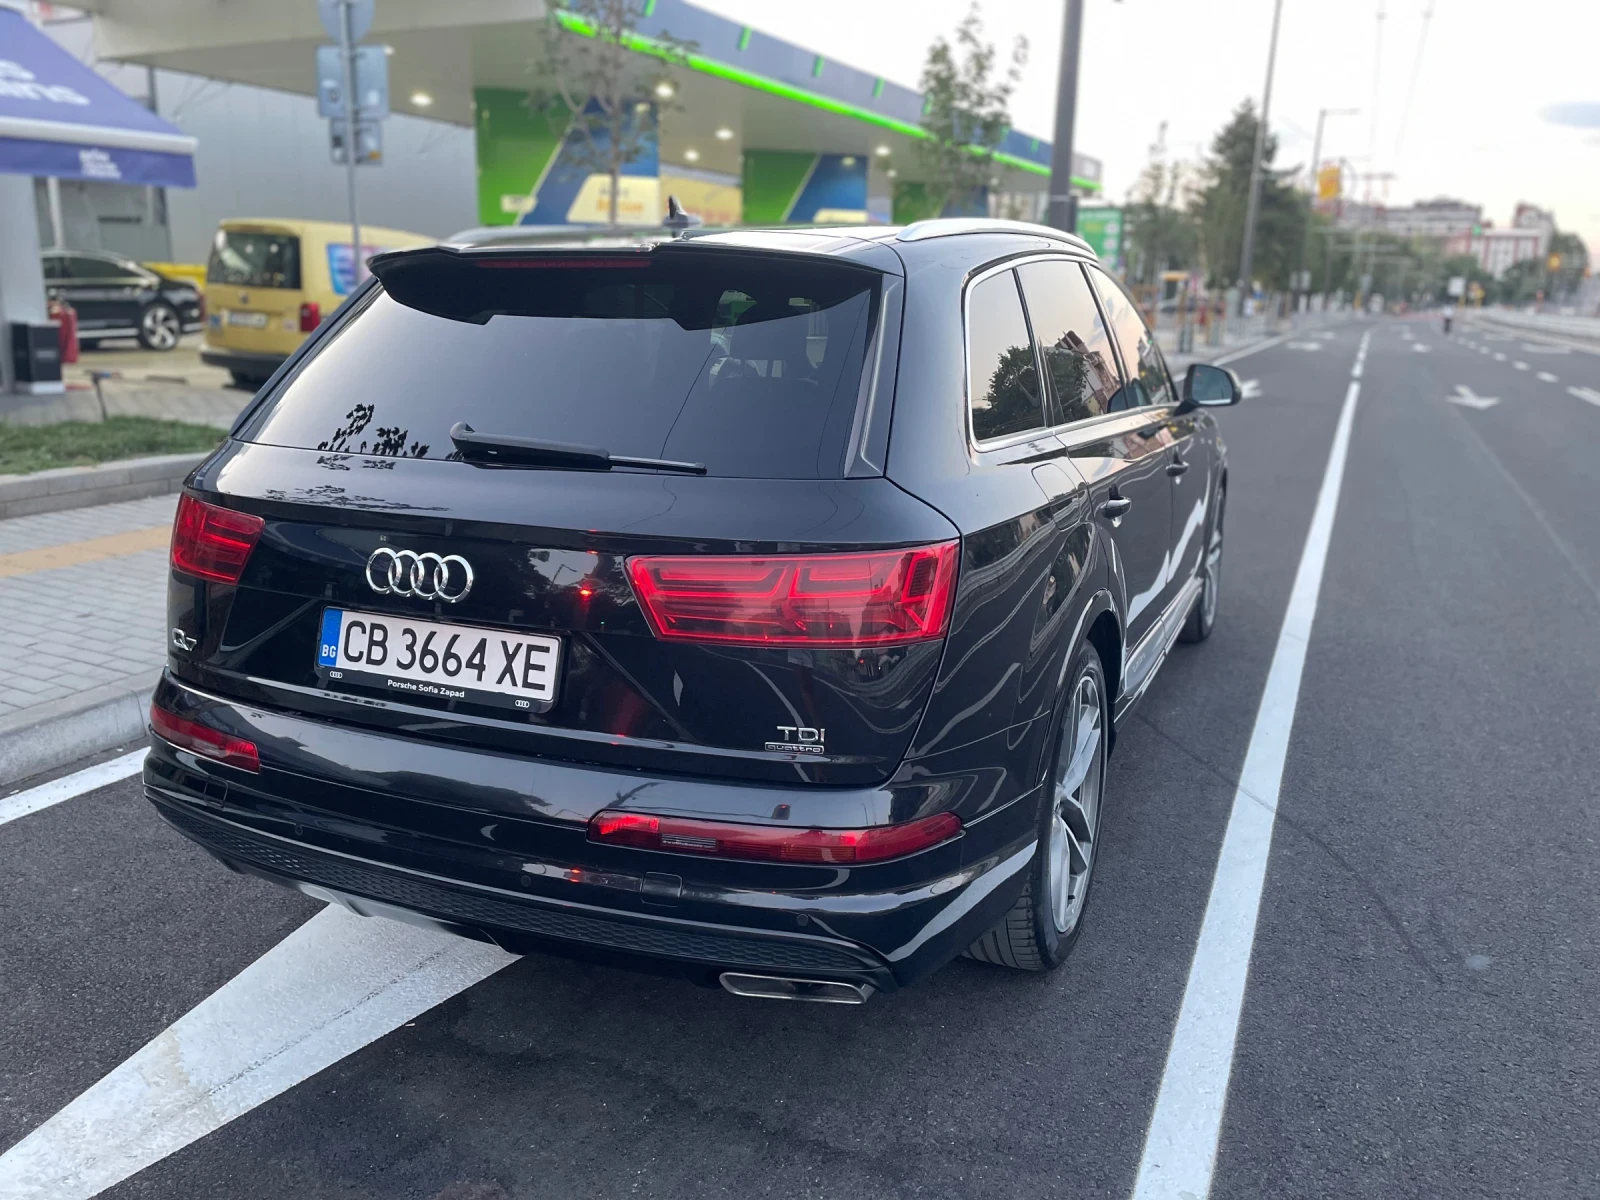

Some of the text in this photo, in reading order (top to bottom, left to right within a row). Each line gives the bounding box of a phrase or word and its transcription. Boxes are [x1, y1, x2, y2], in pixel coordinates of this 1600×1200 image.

[172, 627, 197, 651] Q7
[321, 644, 337, 658] BG
[343, 620, 551, 691] CB 3664 XE
[387, 679, 465, 698] Porsche Sofia Zapad
[776, 725, 826, 742] TDI
[767, 743, 822, 753] quattro
